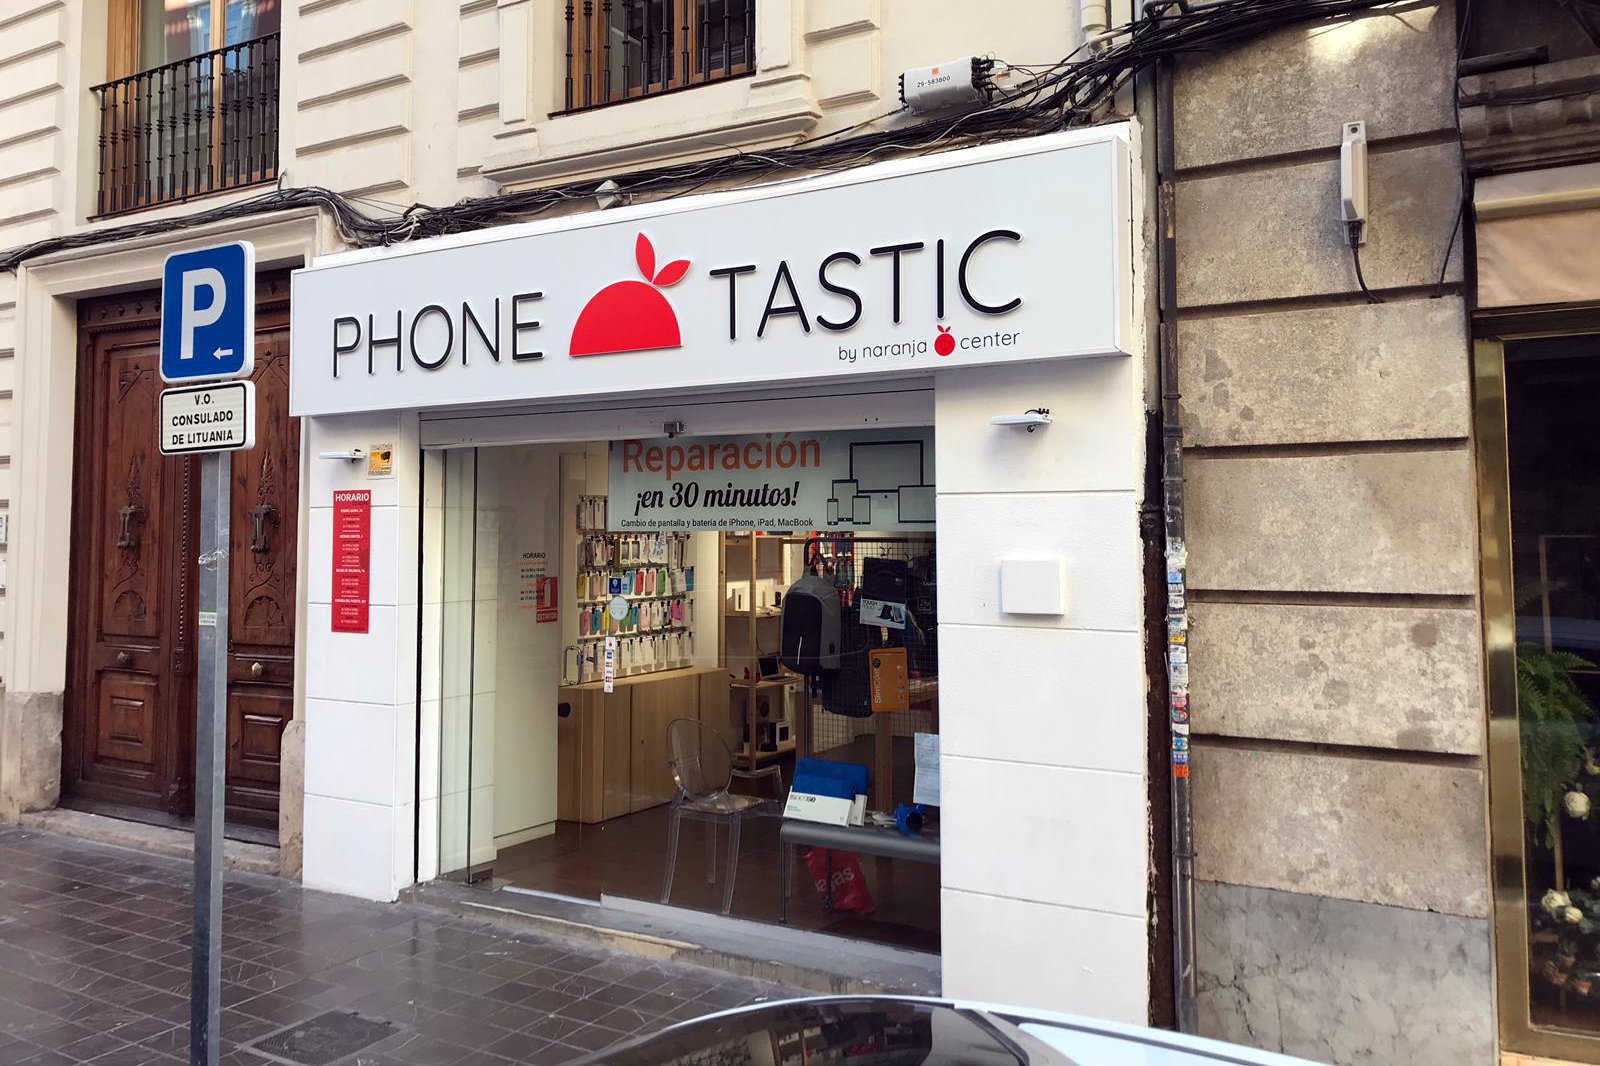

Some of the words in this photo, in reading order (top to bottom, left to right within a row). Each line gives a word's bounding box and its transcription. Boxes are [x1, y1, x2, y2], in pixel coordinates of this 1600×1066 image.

[180, 267, 227, 360] P
[333, 291, 544, 379] PHONE
[709, 229, 1022, 340] TASTIC
[838, 346, 857, 363] by
[862, 339, 927, 358] naranja
[960, 330, 1020, 350] center
[194, 393, 215, 405] V.O.
[172, 410, 233, 426] CONSULADO
[172, 434, 184, 445] DE
[187, 429, 233, 444] LITUANIA
[623, 432, 821, 480] Reparación
[335, 493, 370, 502] HORARIO
[634, 490, 664, 516] ¡en
[670, 482, 699, 508] 30
[703, 481, 800, 507] minutos!
[621, 519, 647, 528] Cambio
[648, 519, 657, 527] de
[657, 519, 685, 529] pantalla
[686, 521, 691, 529] y
[718, 518, 728, 527] de
[729, 518, 756, 528] iPhone,
[757, 518, 776, 528] iPad,
[778, 518, 814, 527] MacBook
